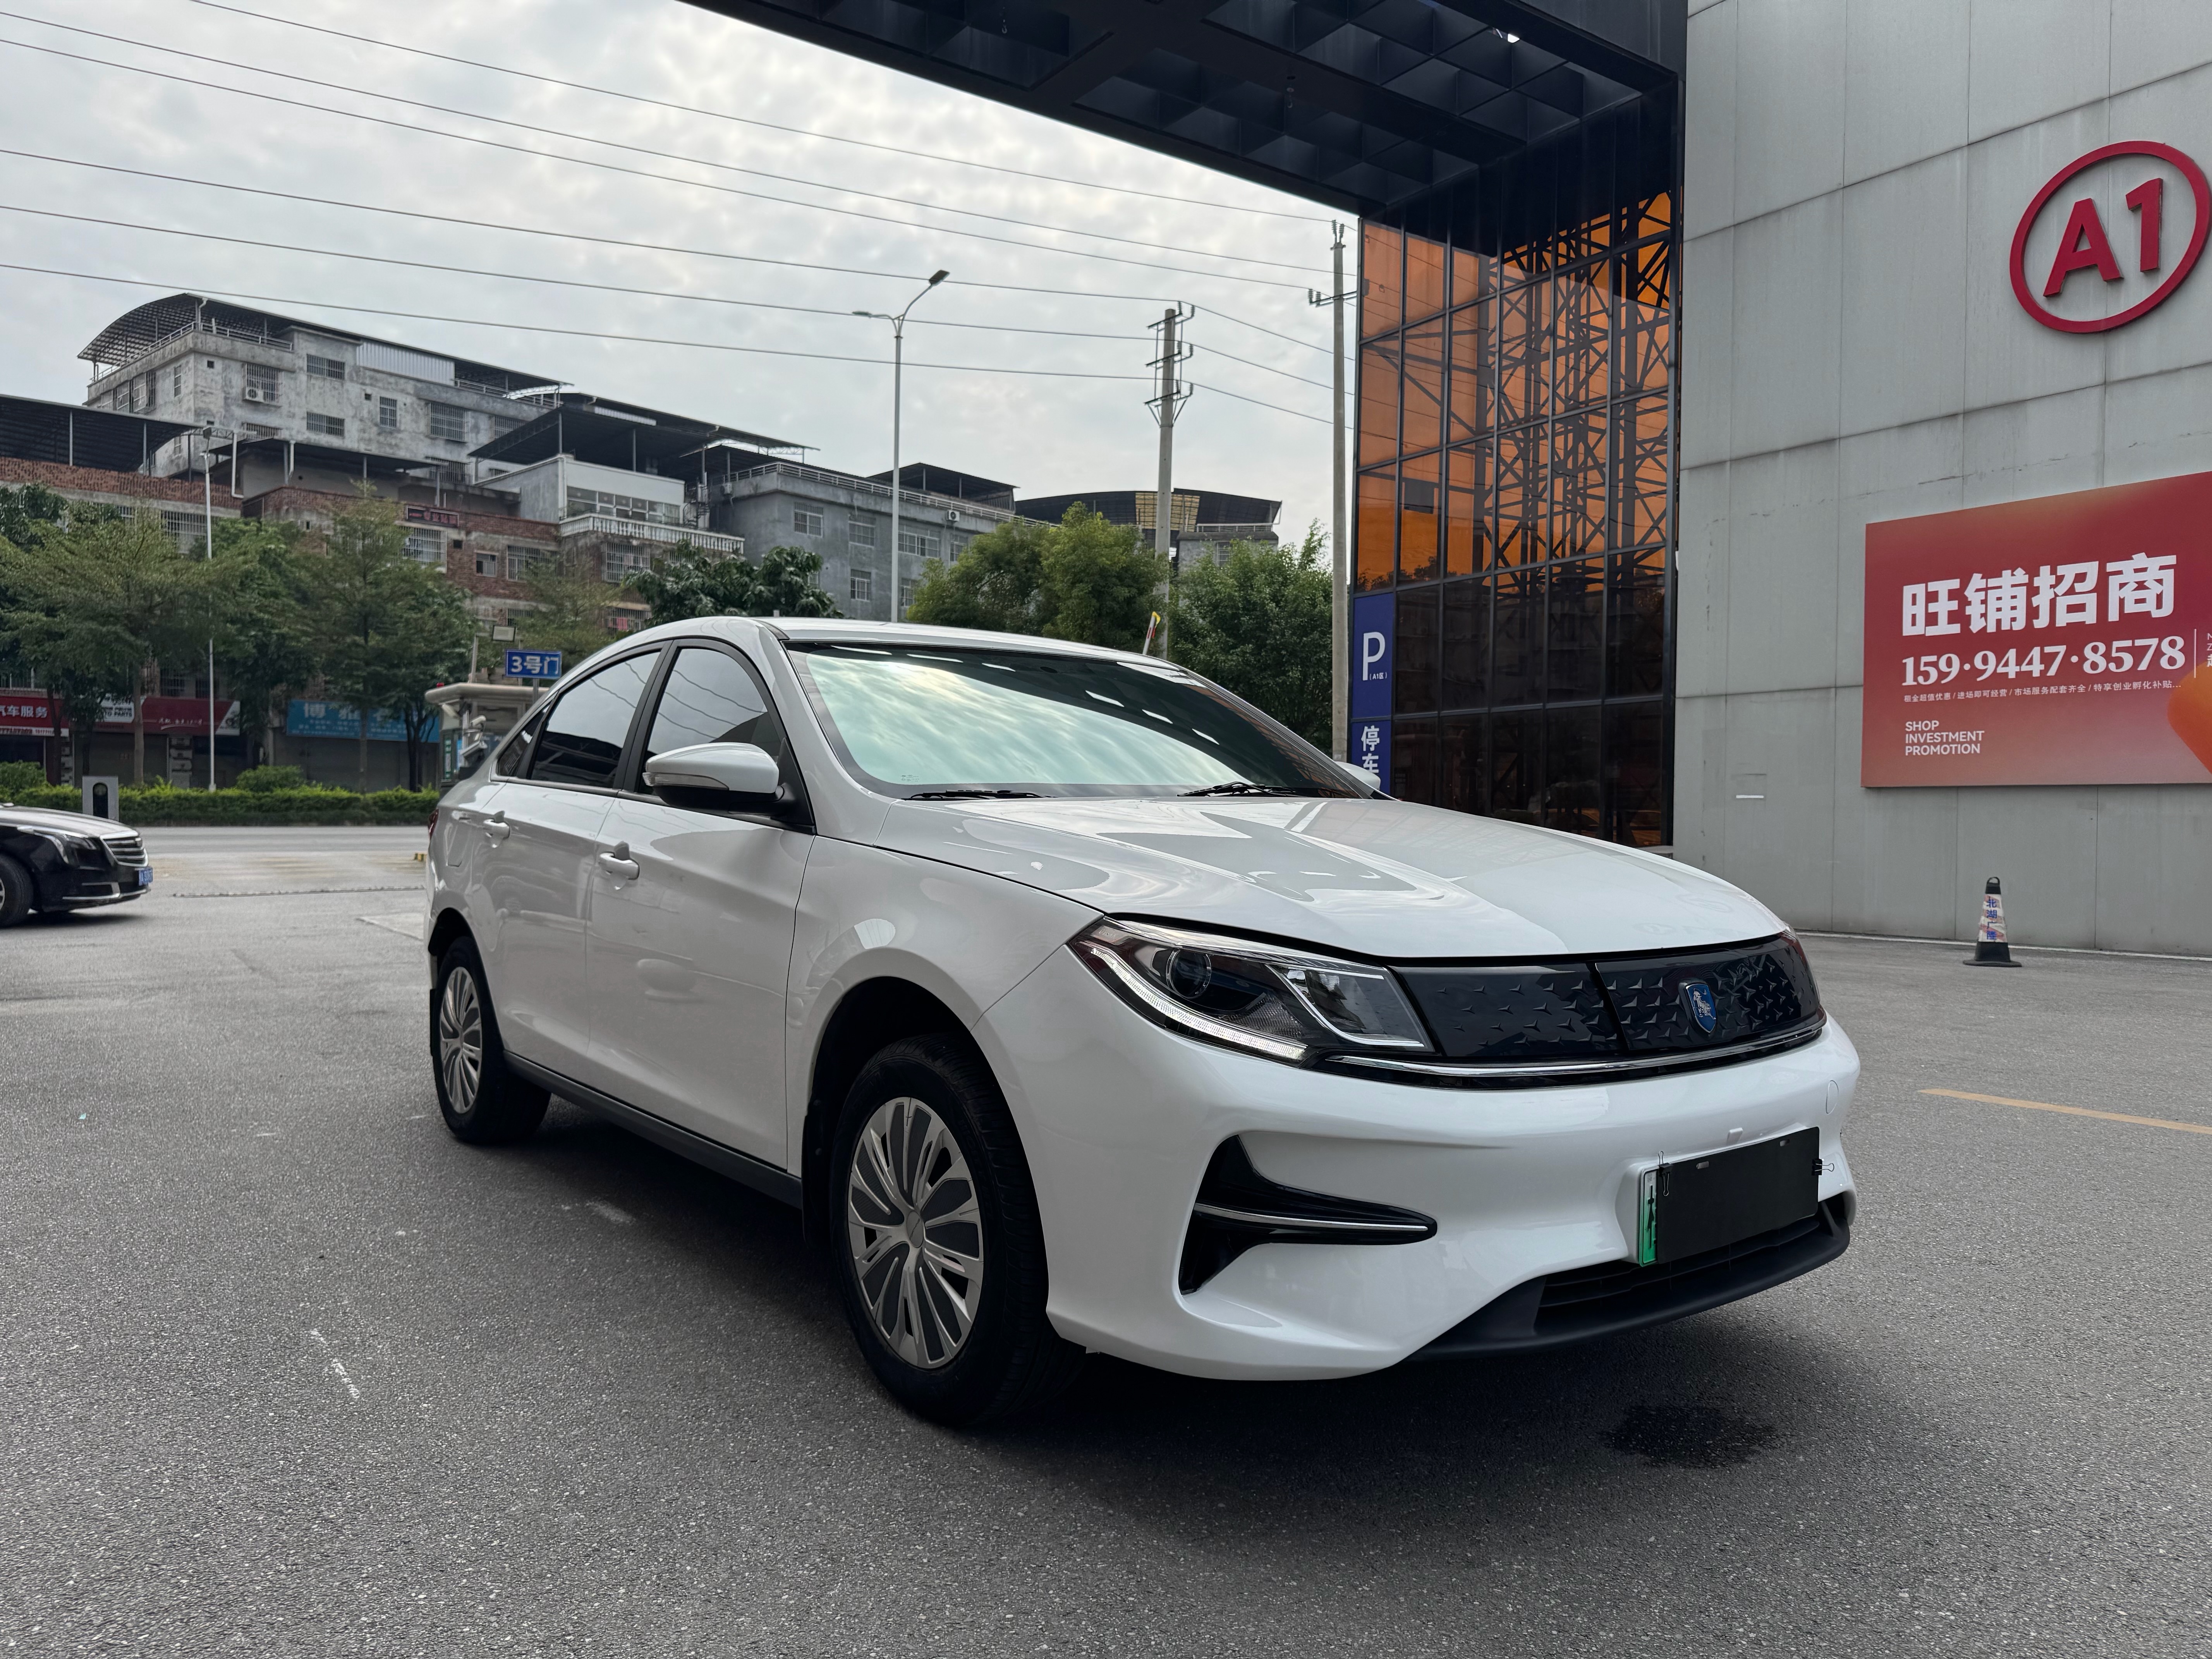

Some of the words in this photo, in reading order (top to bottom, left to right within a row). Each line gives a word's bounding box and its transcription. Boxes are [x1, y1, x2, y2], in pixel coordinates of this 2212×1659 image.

[2043, 178, 2163, 297] A1
[1903, 553, 2176, 636] 旺铺招商
[511, 655, 559, 674] 3号门
[1363, 632, 1385, 680] P
[1904, 692, 1951, 702] 租金超值优惠
[1958, 689, 2007, 699] 进场即可经营
[2014, 684, 2086, 696] 市场服务配套齐全
[1906, 720, 1939, 731] SHOP
[1906, 730, 1984, 744] INVESTMENT
[1906, 744, 1980, 756] PROMOTION
